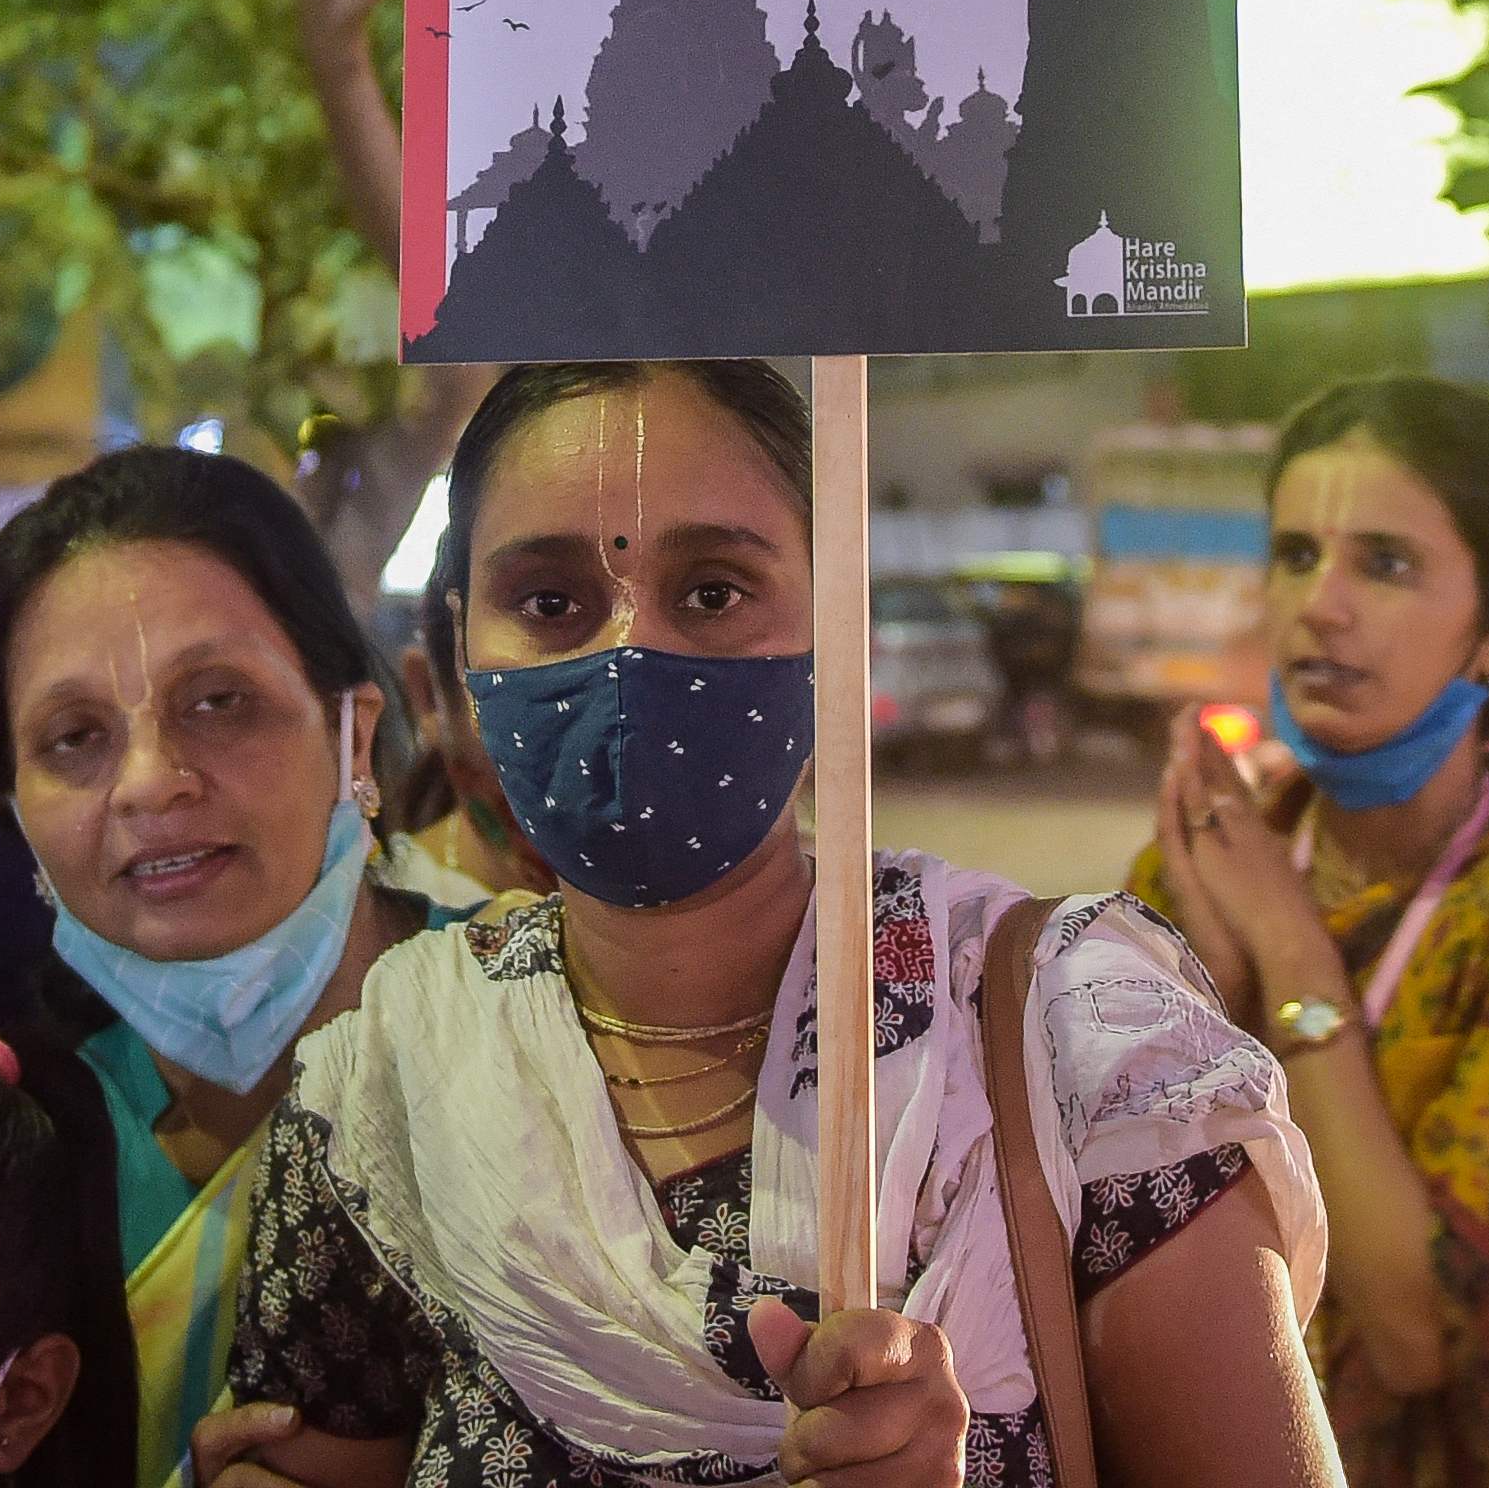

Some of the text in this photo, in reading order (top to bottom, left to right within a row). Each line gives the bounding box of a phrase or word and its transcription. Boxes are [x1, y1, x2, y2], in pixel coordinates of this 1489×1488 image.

[1125, 237, 1176, 258] Hare
[1125, 258, 1207, 280] Krishna
[1125, 280, 1204, 301] Mandir
